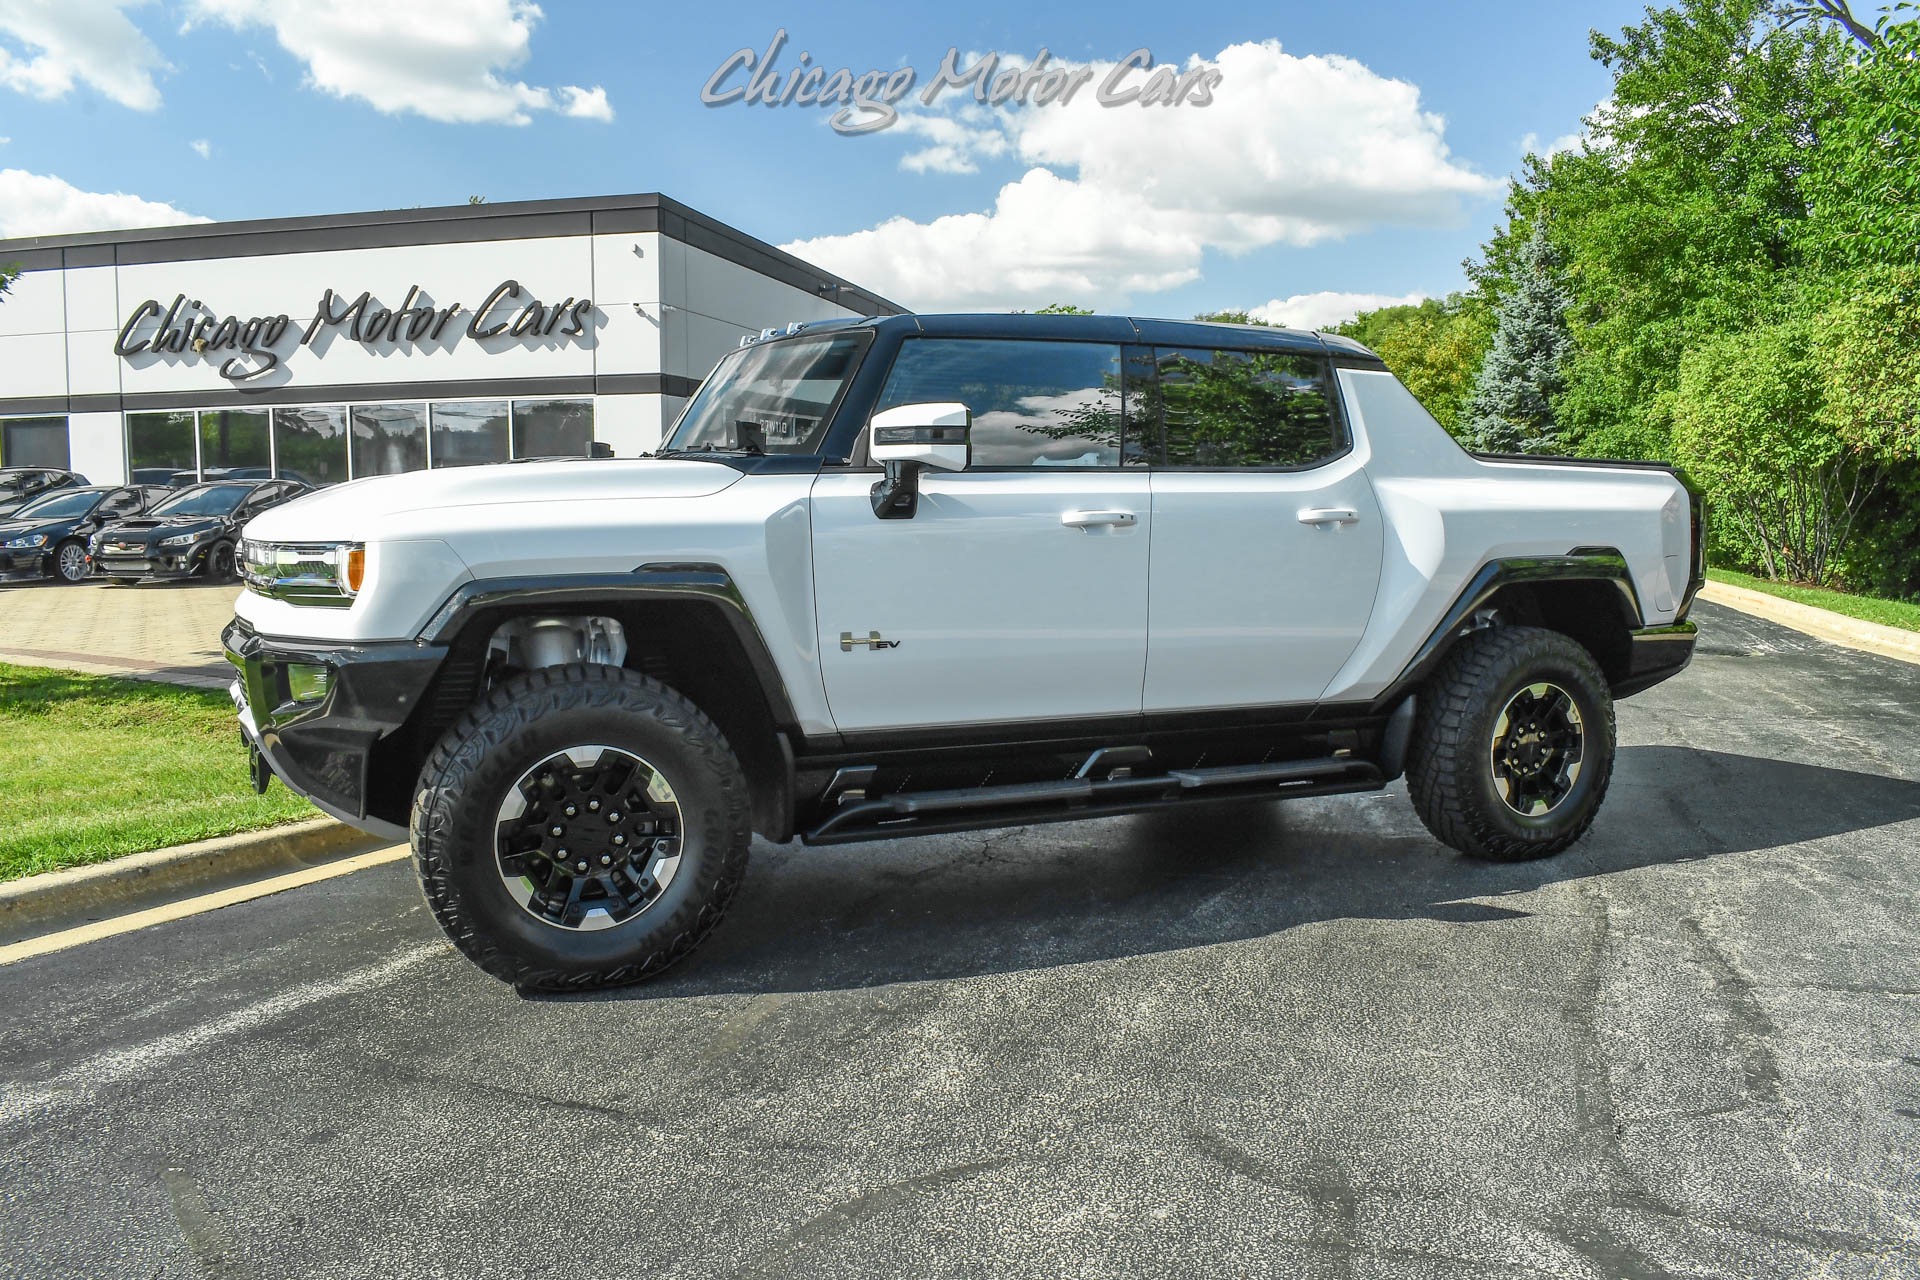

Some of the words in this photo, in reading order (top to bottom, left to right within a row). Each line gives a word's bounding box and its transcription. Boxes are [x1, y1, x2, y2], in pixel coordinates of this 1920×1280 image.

[114, 293, 289, 380] Chicago
[300, 284, 461, 345] Motor
[466, 279, 591, 340] Cars
